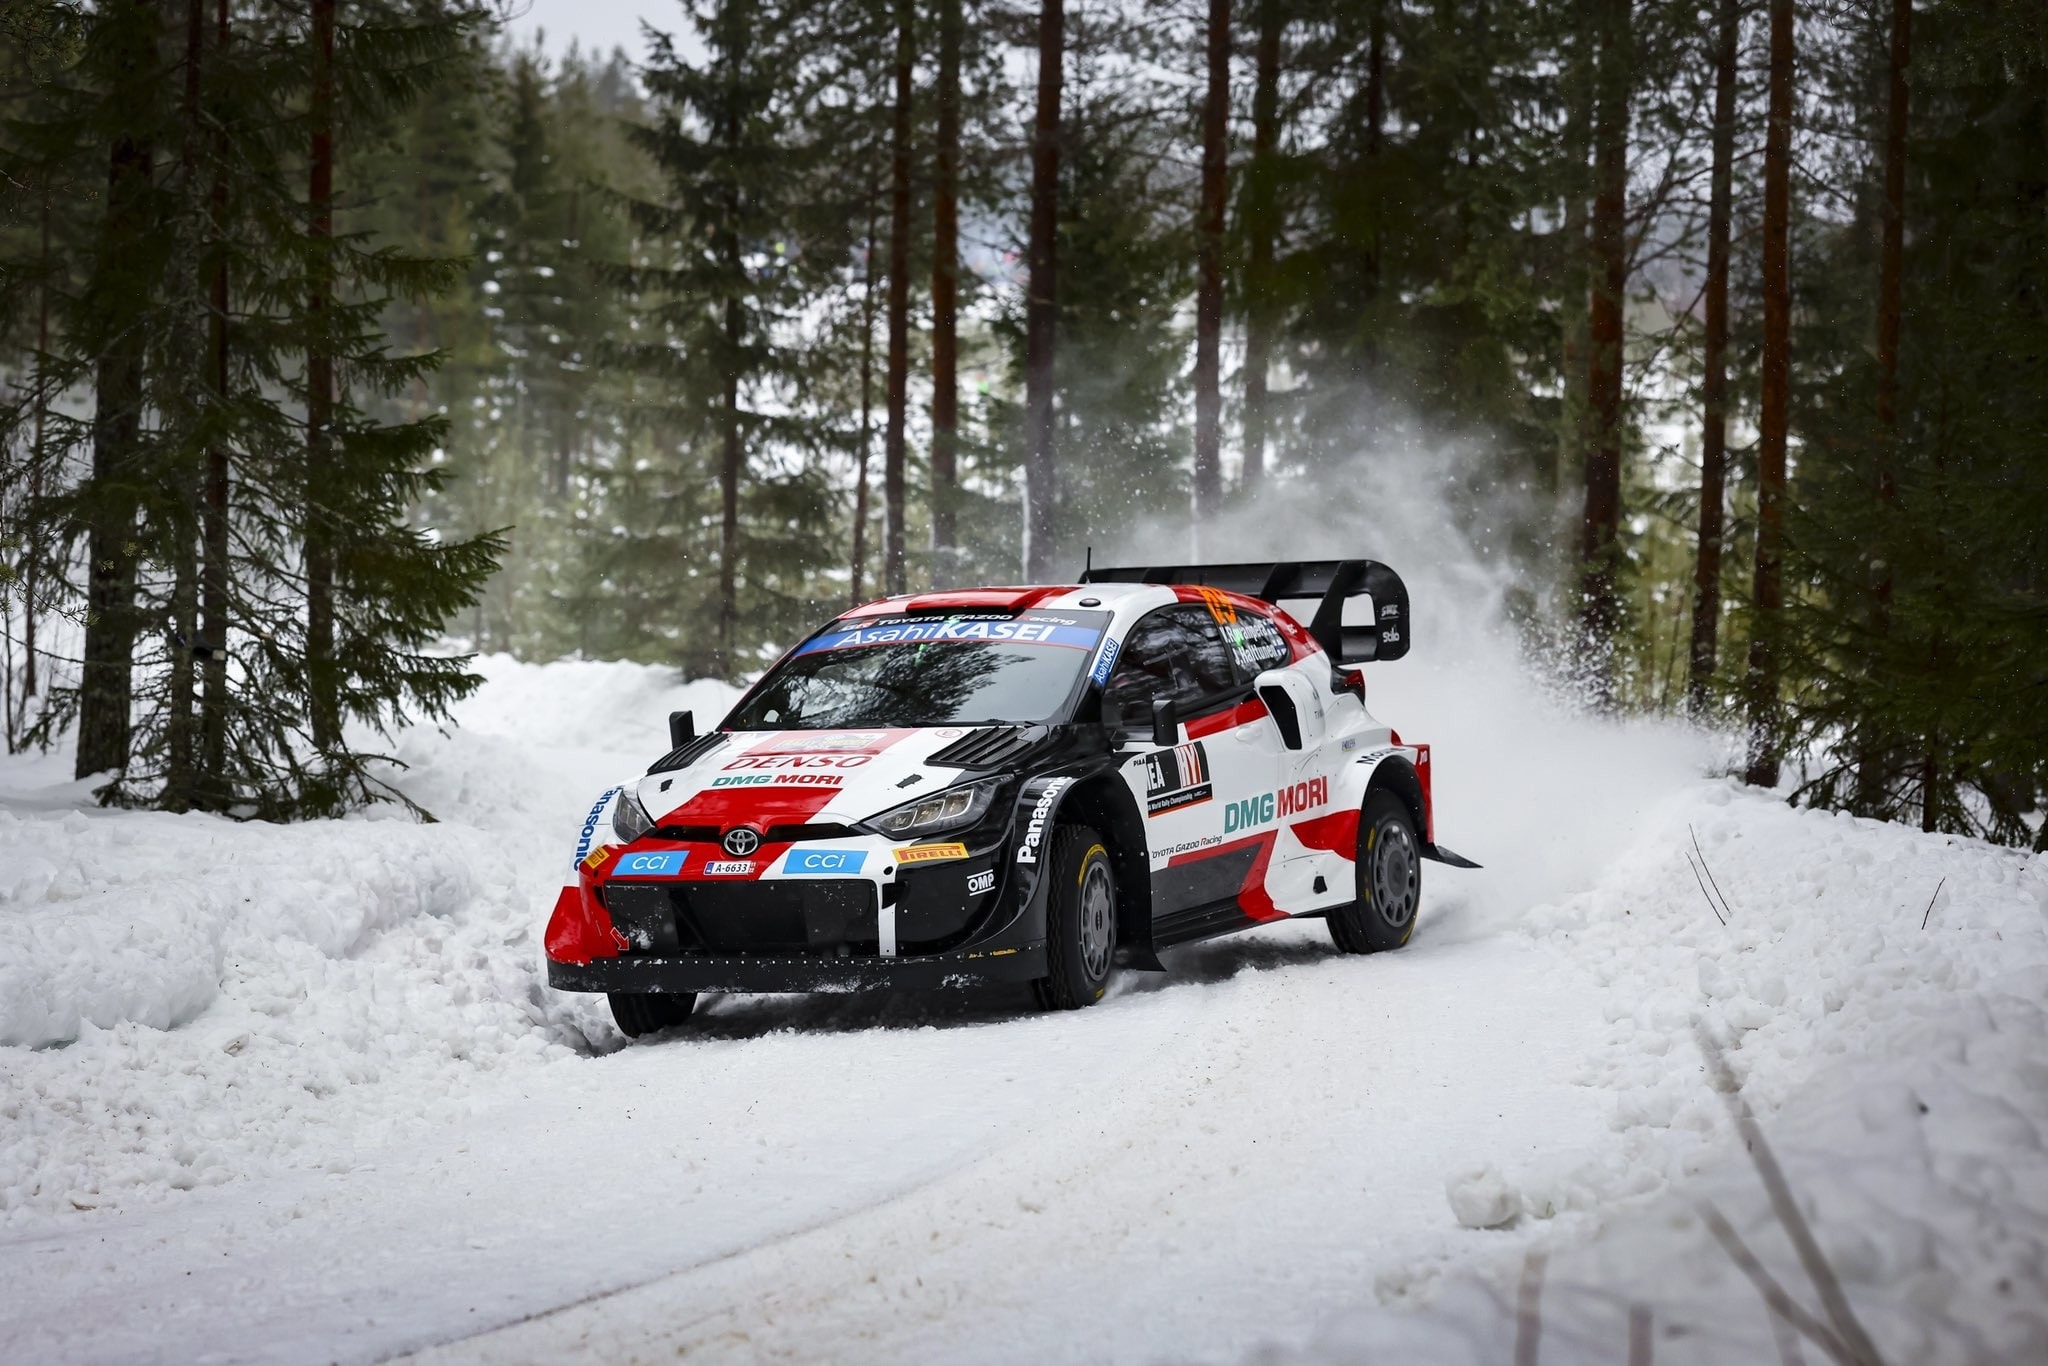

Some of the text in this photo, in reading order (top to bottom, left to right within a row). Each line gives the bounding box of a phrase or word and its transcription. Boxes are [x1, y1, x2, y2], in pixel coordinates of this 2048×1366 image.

[879, 615, 944, 625] TOYOTA
[722, 756, 872, 770] DENSO
[712, 775, 844, 787] DMG MORI
[1224, 776, 1328, 834] DMG MORI
[1017, 776, 1072, 864] Panasonic
[900, 845, 963, 861] PIRELLI
[1152, 836, 1223, 859] OYOTA GAZOO Racing
[715, 863, 748, 873] A-6633
[967, 873, 995, 892] OMP
